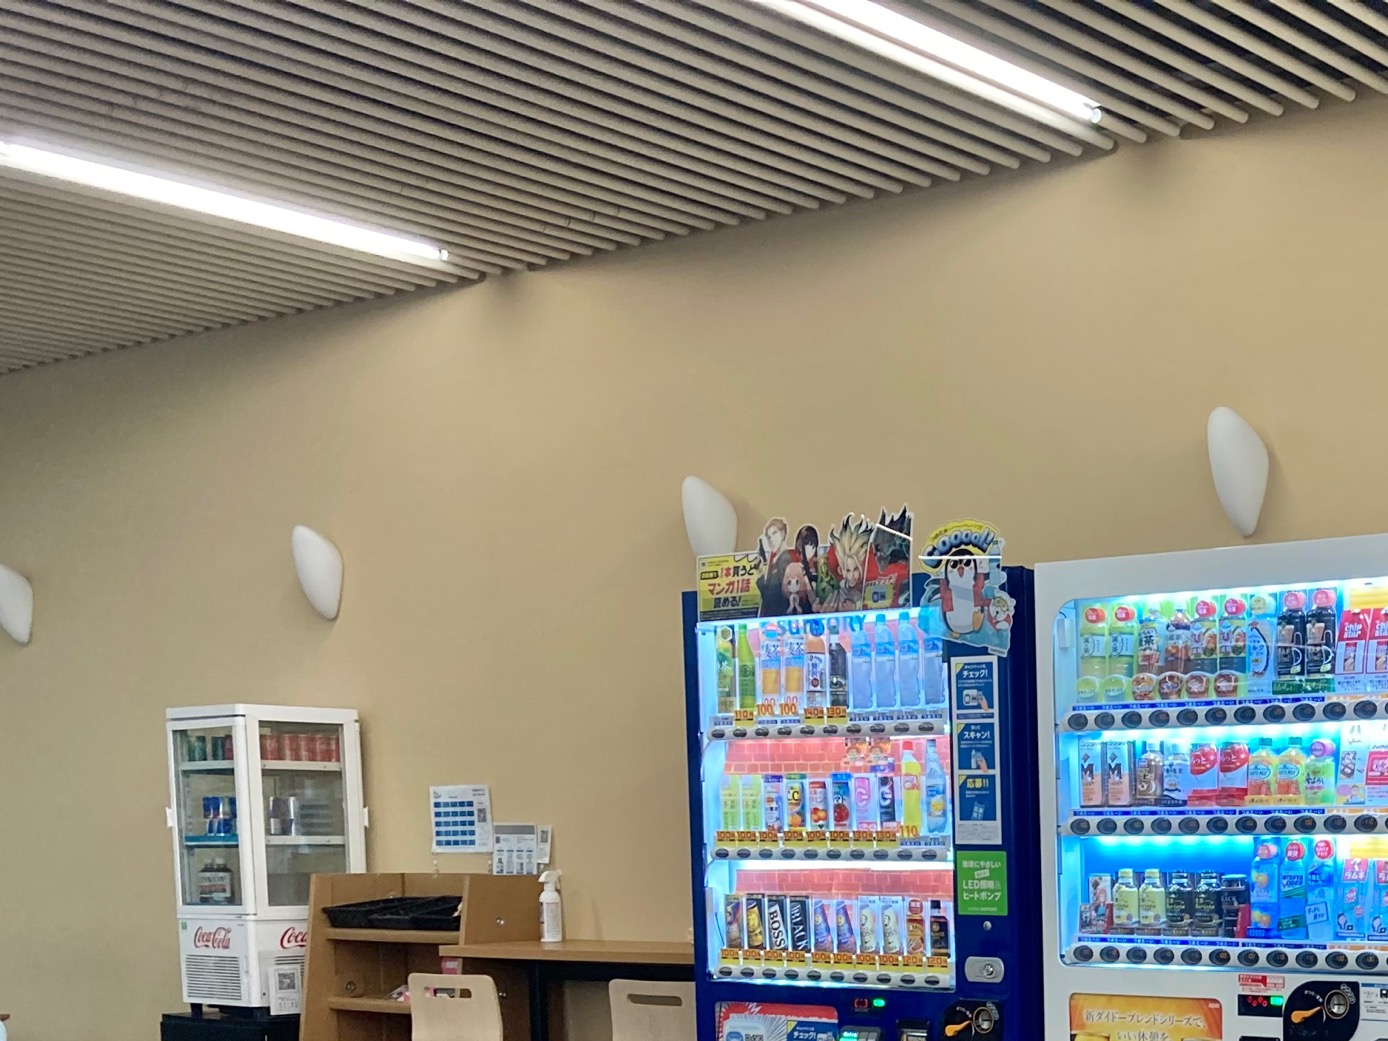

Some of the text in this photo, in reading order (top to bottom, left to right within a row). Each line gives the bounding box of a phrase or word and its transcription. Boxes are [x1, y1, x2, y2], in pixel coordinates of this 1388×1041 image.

[1344, 872, 1366, 880] ラムネ
[963, 890, 1002, 901] ヒートポンプ
[769, 909, 786, 950] BOSS
